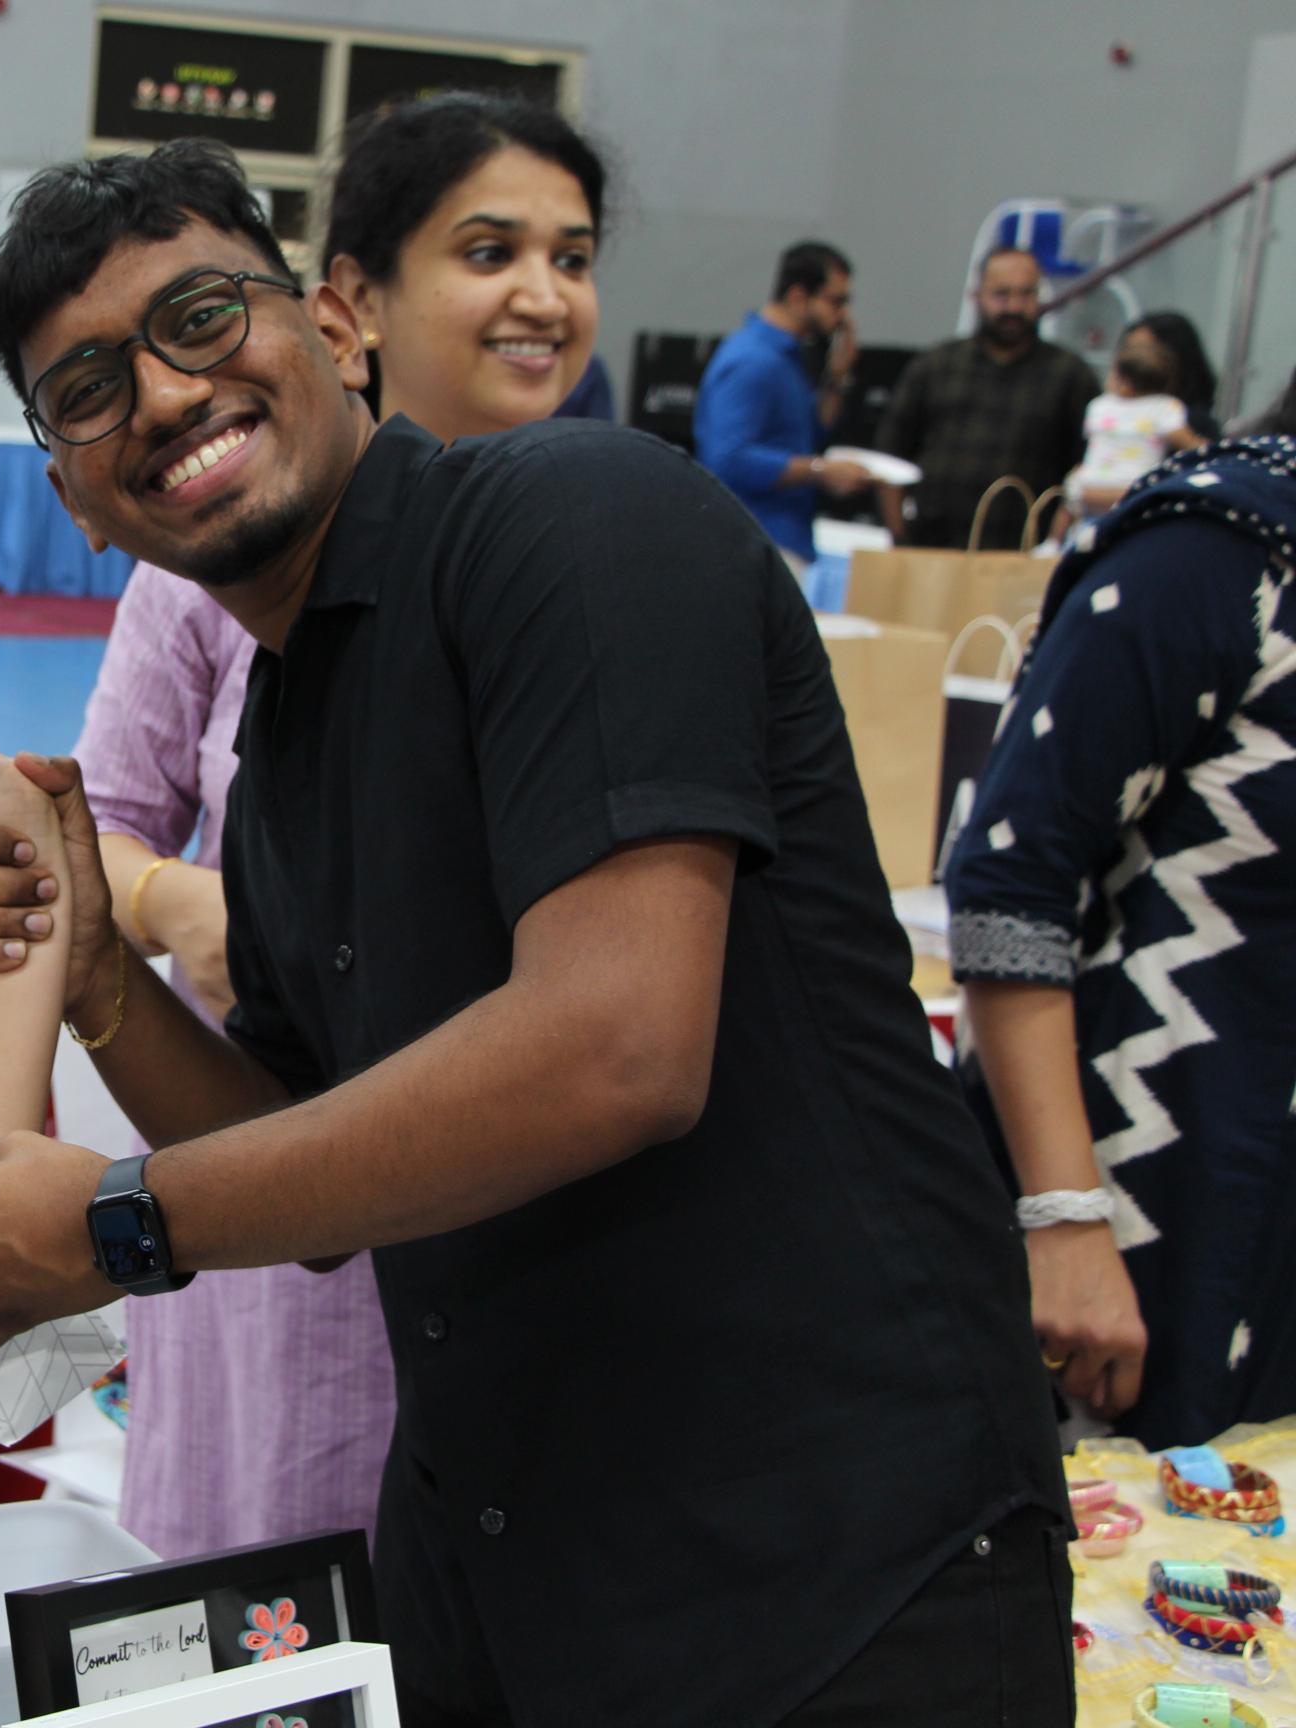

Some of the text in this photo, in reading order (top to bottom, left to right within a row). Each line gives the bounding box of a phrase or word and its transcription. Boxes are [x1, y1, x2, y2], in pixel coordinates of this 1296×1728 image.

[75, 1622, 207, 1676] Commit to the Lord
